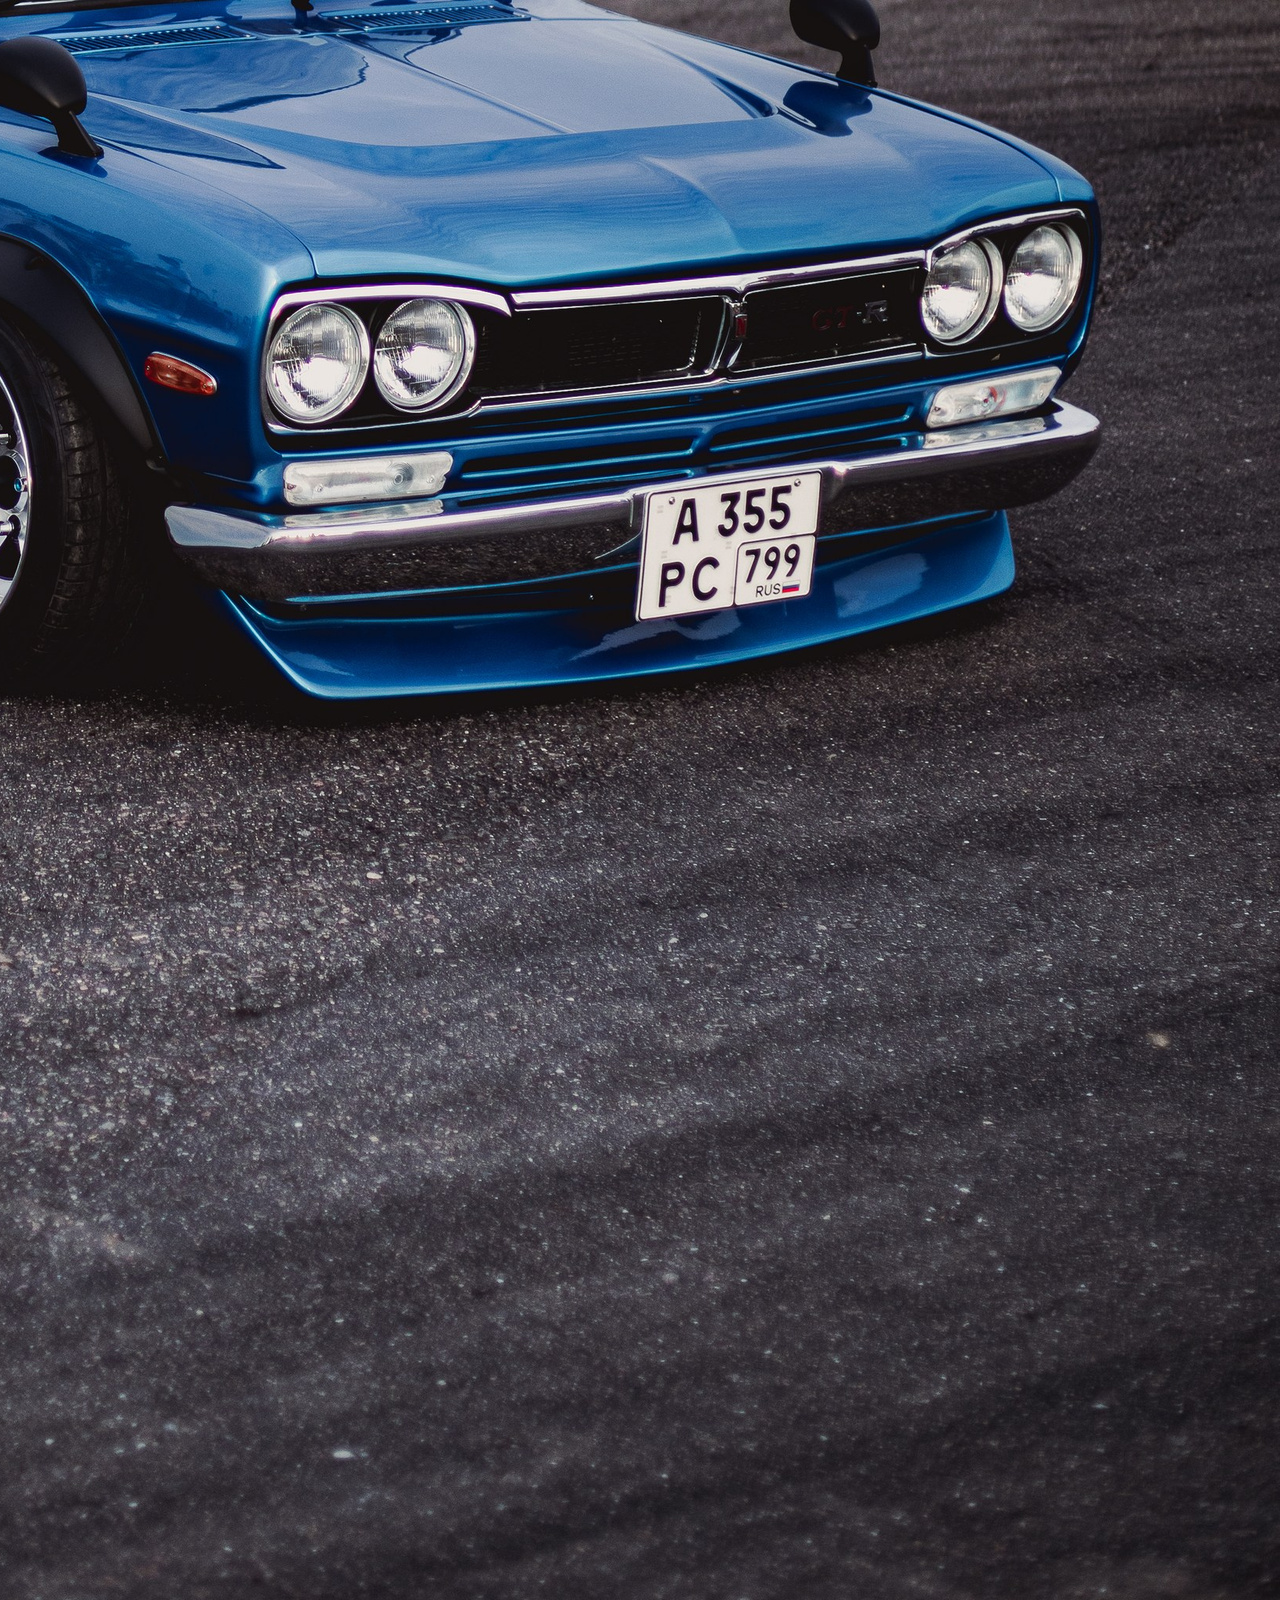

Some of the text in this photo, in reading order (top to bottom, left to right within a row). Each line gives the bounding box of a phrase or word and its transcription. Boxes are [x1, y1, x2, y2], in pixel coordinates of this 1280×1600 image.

[811, 300, 888, 332] GT-R
[672, 485, 793, 546] A 355
[745, 543, 801, 584] 799
[755, 583, 781, 598] RUS
